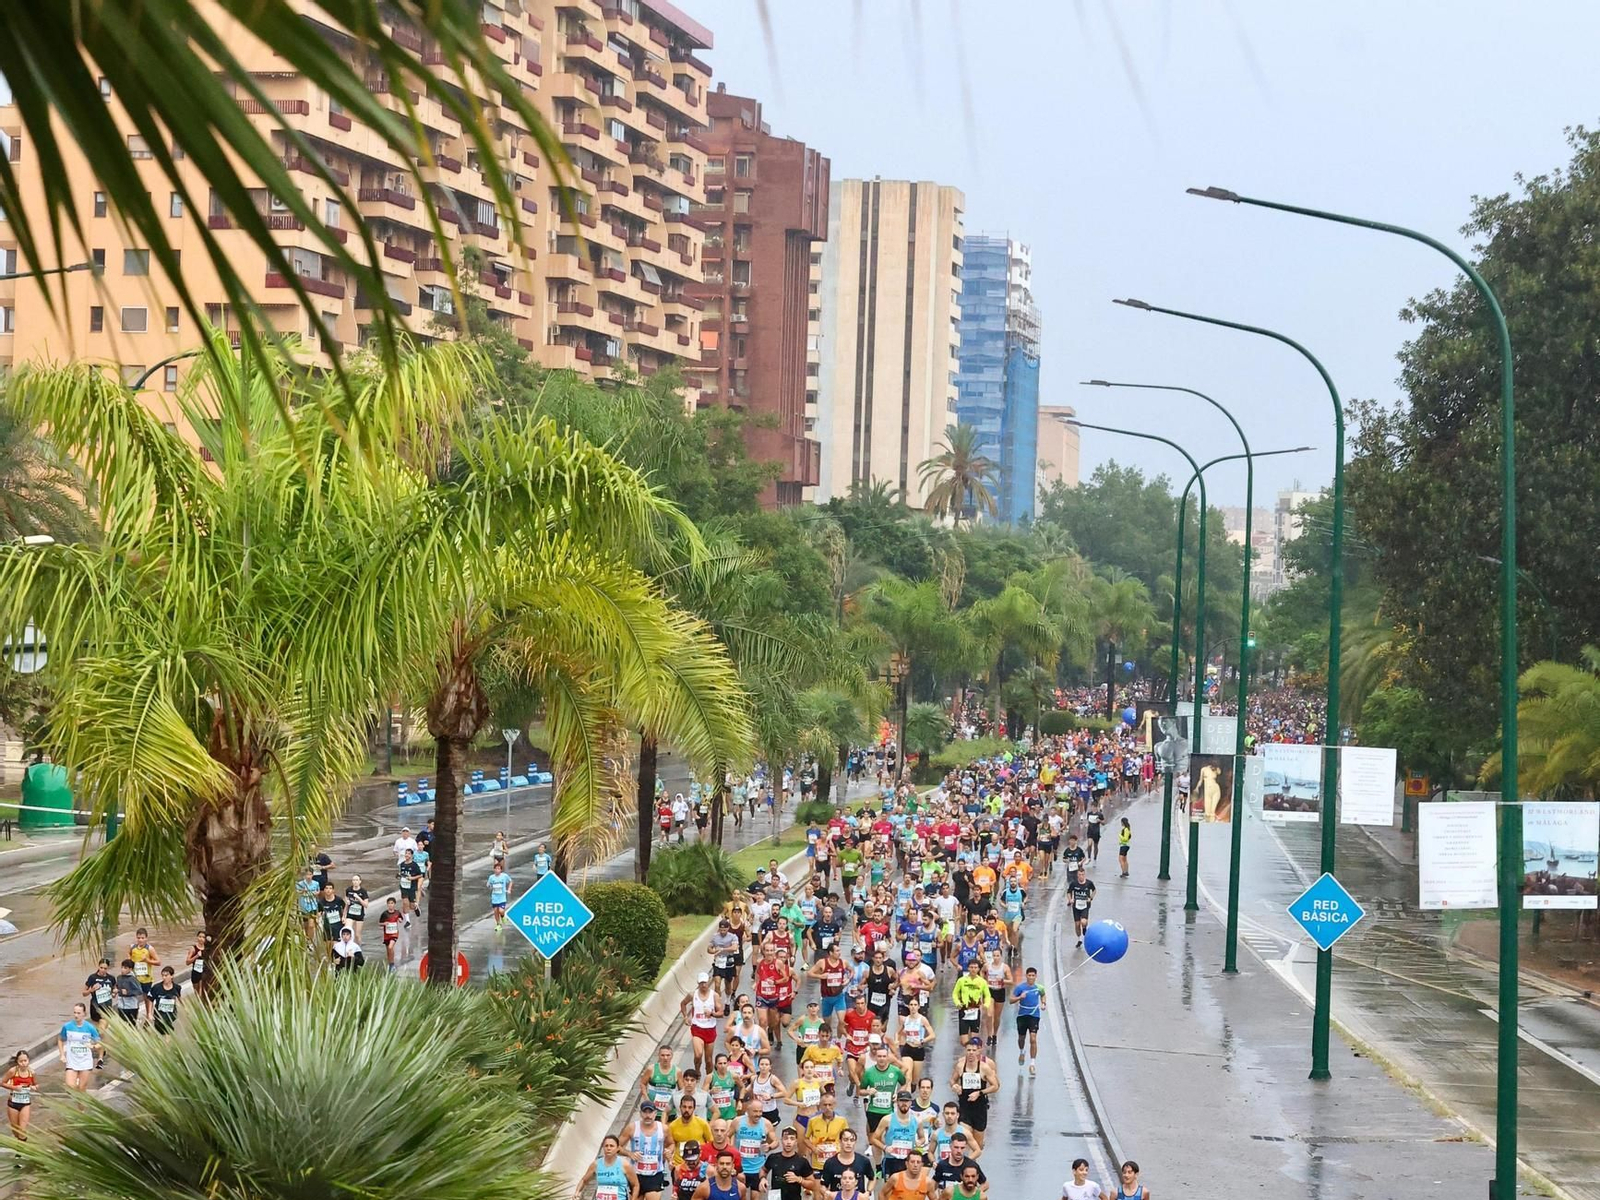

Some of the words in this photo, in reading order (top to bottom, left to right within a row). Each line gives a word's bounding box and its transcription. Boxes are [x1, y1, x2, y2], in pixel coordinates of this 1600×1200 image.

[535, 902, 564, 914] RED
[1313, 900, 1339, 910] RED
[1302, 910, 1349, 923] BÁSICA
